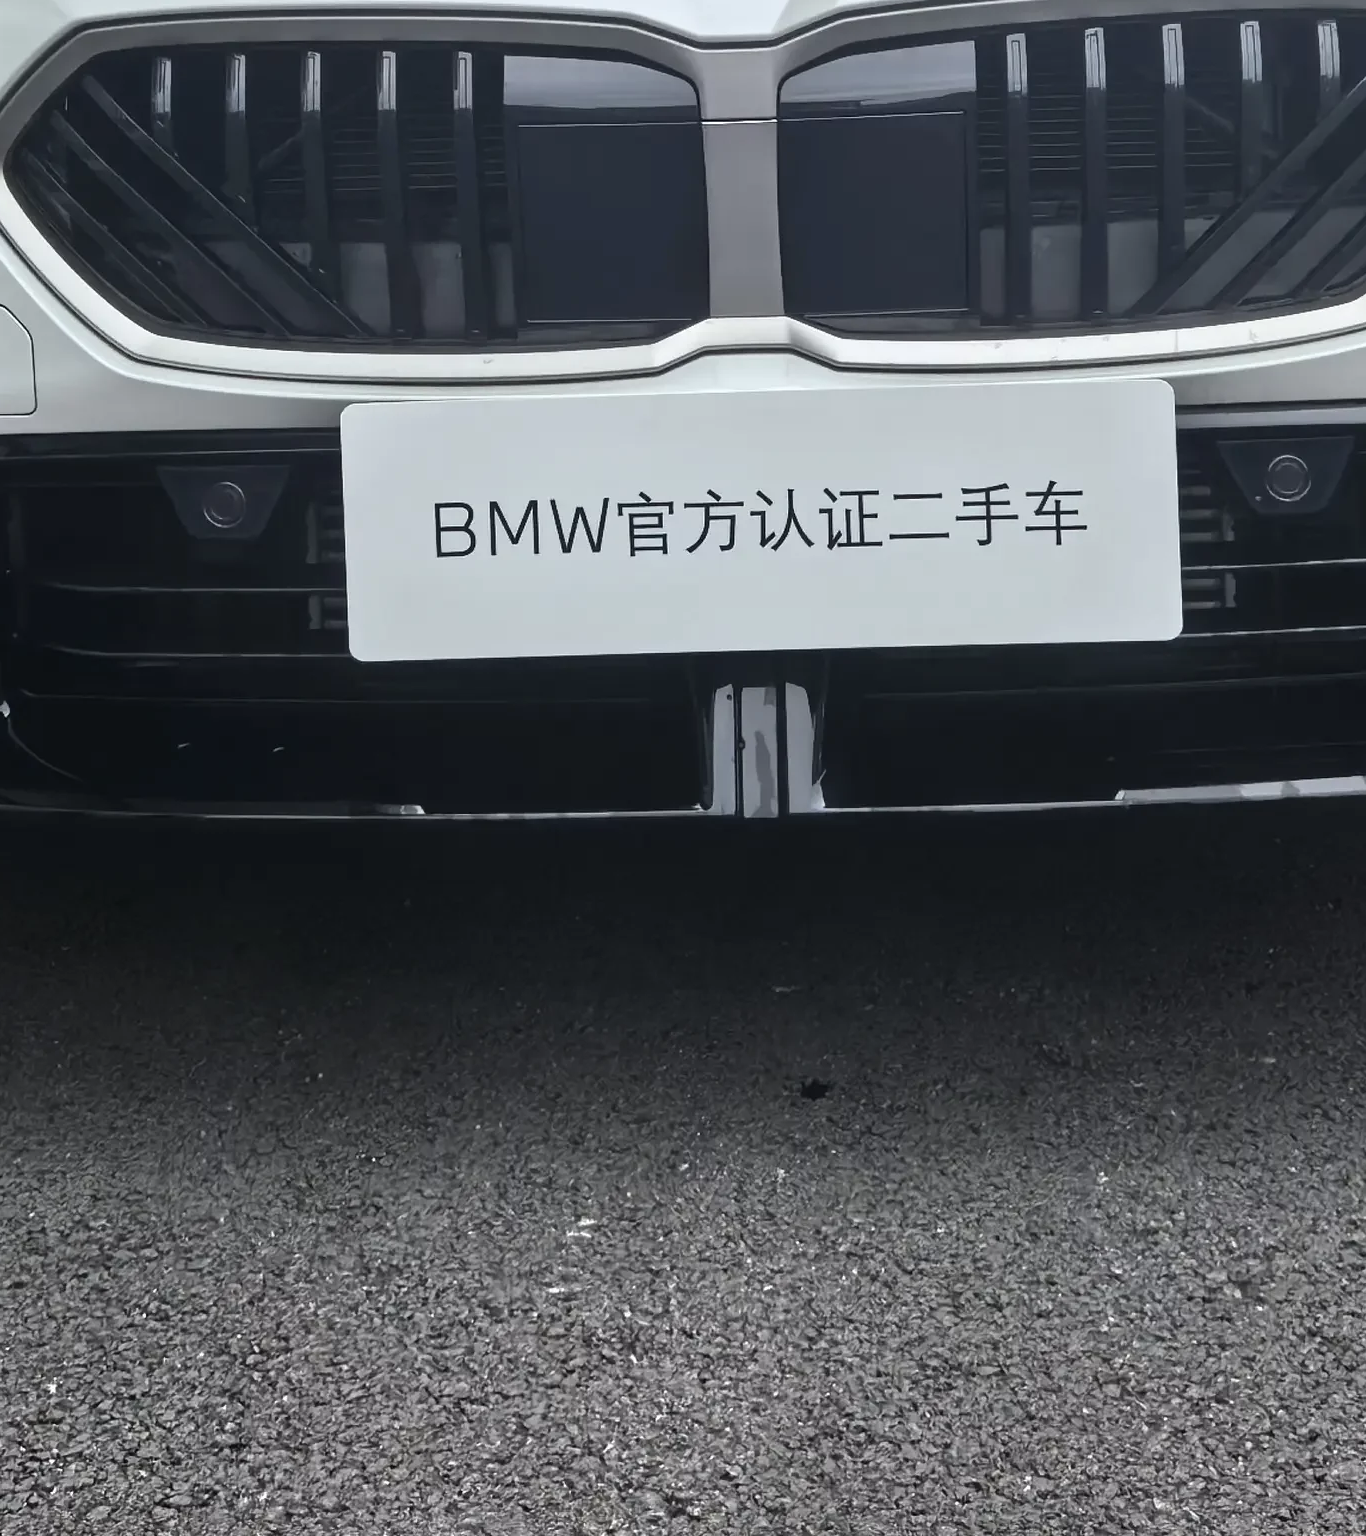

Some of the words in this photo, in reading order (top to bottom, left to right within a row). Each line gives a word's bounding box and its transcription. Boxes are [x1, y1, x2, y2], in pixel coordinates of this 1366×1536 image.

[434, 479, 1088, 559] BMW官方认证二手车
